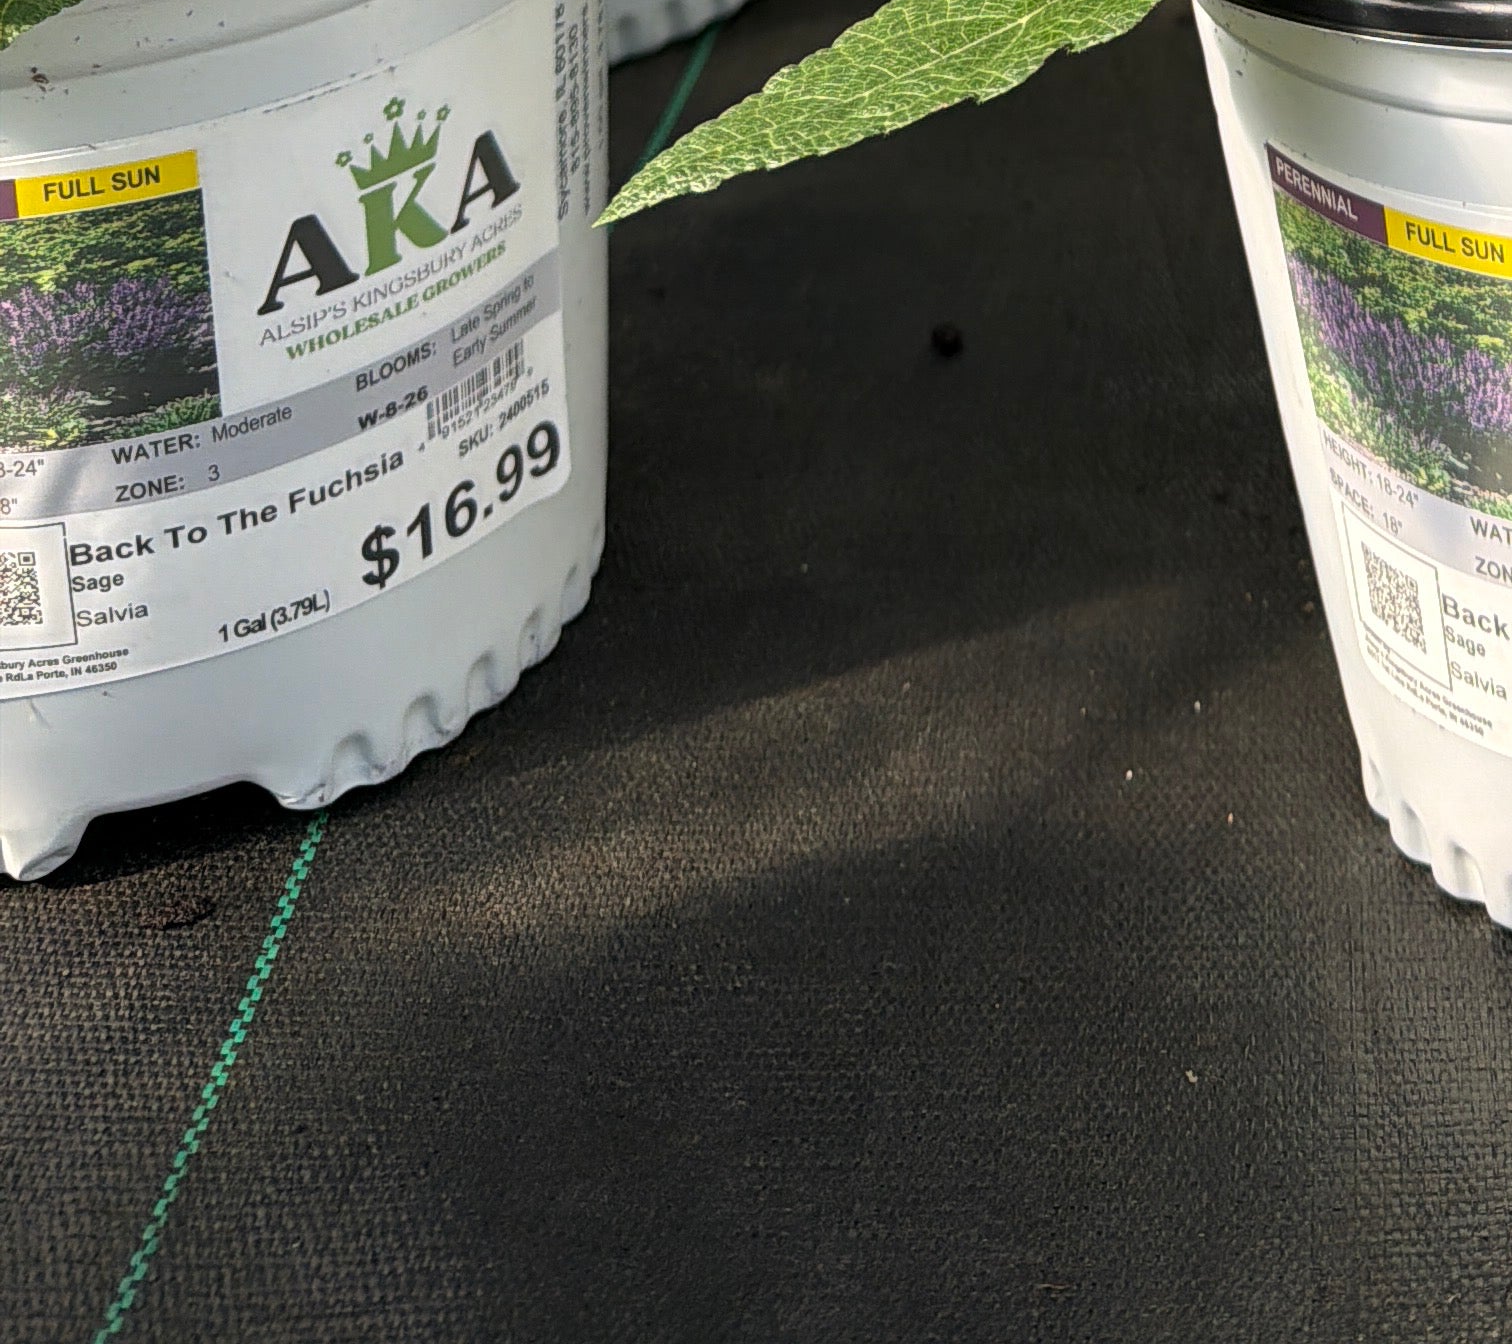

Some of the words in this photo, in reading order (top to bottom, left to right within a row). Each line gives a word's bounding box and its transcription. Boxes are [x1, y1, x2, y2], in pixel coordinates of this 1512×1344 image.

[43, 177, 105, 202] FULL
[111, 165, 161, 192] SUN
[1275, 156, 1358, 222] PERENNIAL
[257, 129, 521, 316] AKA
[1405, 221, 1455, 254] FULL
[1461, 236, 1505, 263] SUN
[259, 300, 348, 346] ALSIP'S
[352, 243, 467, 313] KINGSBURY
[470, 204, 523, 254] ACRES
[285, 293, 420, 361] WHOLESALE
[422, 240, 507, 304] GROWERS
[356, 341, 437, 393] BLOOMS:
[451, 315, 480, 344] Late
[484, 285, 522, 322] Spring
[523, 274, 534, 291] to
[453, 335, 487, 368] Early
[489, 296, 537, 342] Summer
[358, 385, 429, 431] W-8-26
[458, 423, 494, 459] SKU:
[498, 377, 551, 431] 2400515
[111, 433, 201, 465] WATER:
[211, 405, 293, 443] Moderate
[1323, 428, 1374, 485] HEIGHT:
[70, 534, 155, 566] Back
[163, 525, 208, 549] To
[217, 504, 278, 535] The
[288, 450, 405, 514] Fuchsia
[115, 475, 185, 503] ZONE:
[208, 464, 221, 482] 3
[361, 419, 561, 590] $16.99
[1329, 466, 1375, 518] SPACE:
[71, 572, 125, 593] Sage
[76, 602, 149, 627] Salvia
[218, 624, 229, 642] 1
[233, 613, 266, 638] Gal
[270, 588, 331, 631] (3.79L)
[1441, 591, 1511, 641] Back
[1444, 624, 1486, 657] Sage
[62, 647, 129, 665] Greenhouse
[70, 665, 83, 677] IN
[85, 661, 118, 676] 46350
[1450, 660, 1508, 701] Salvia
